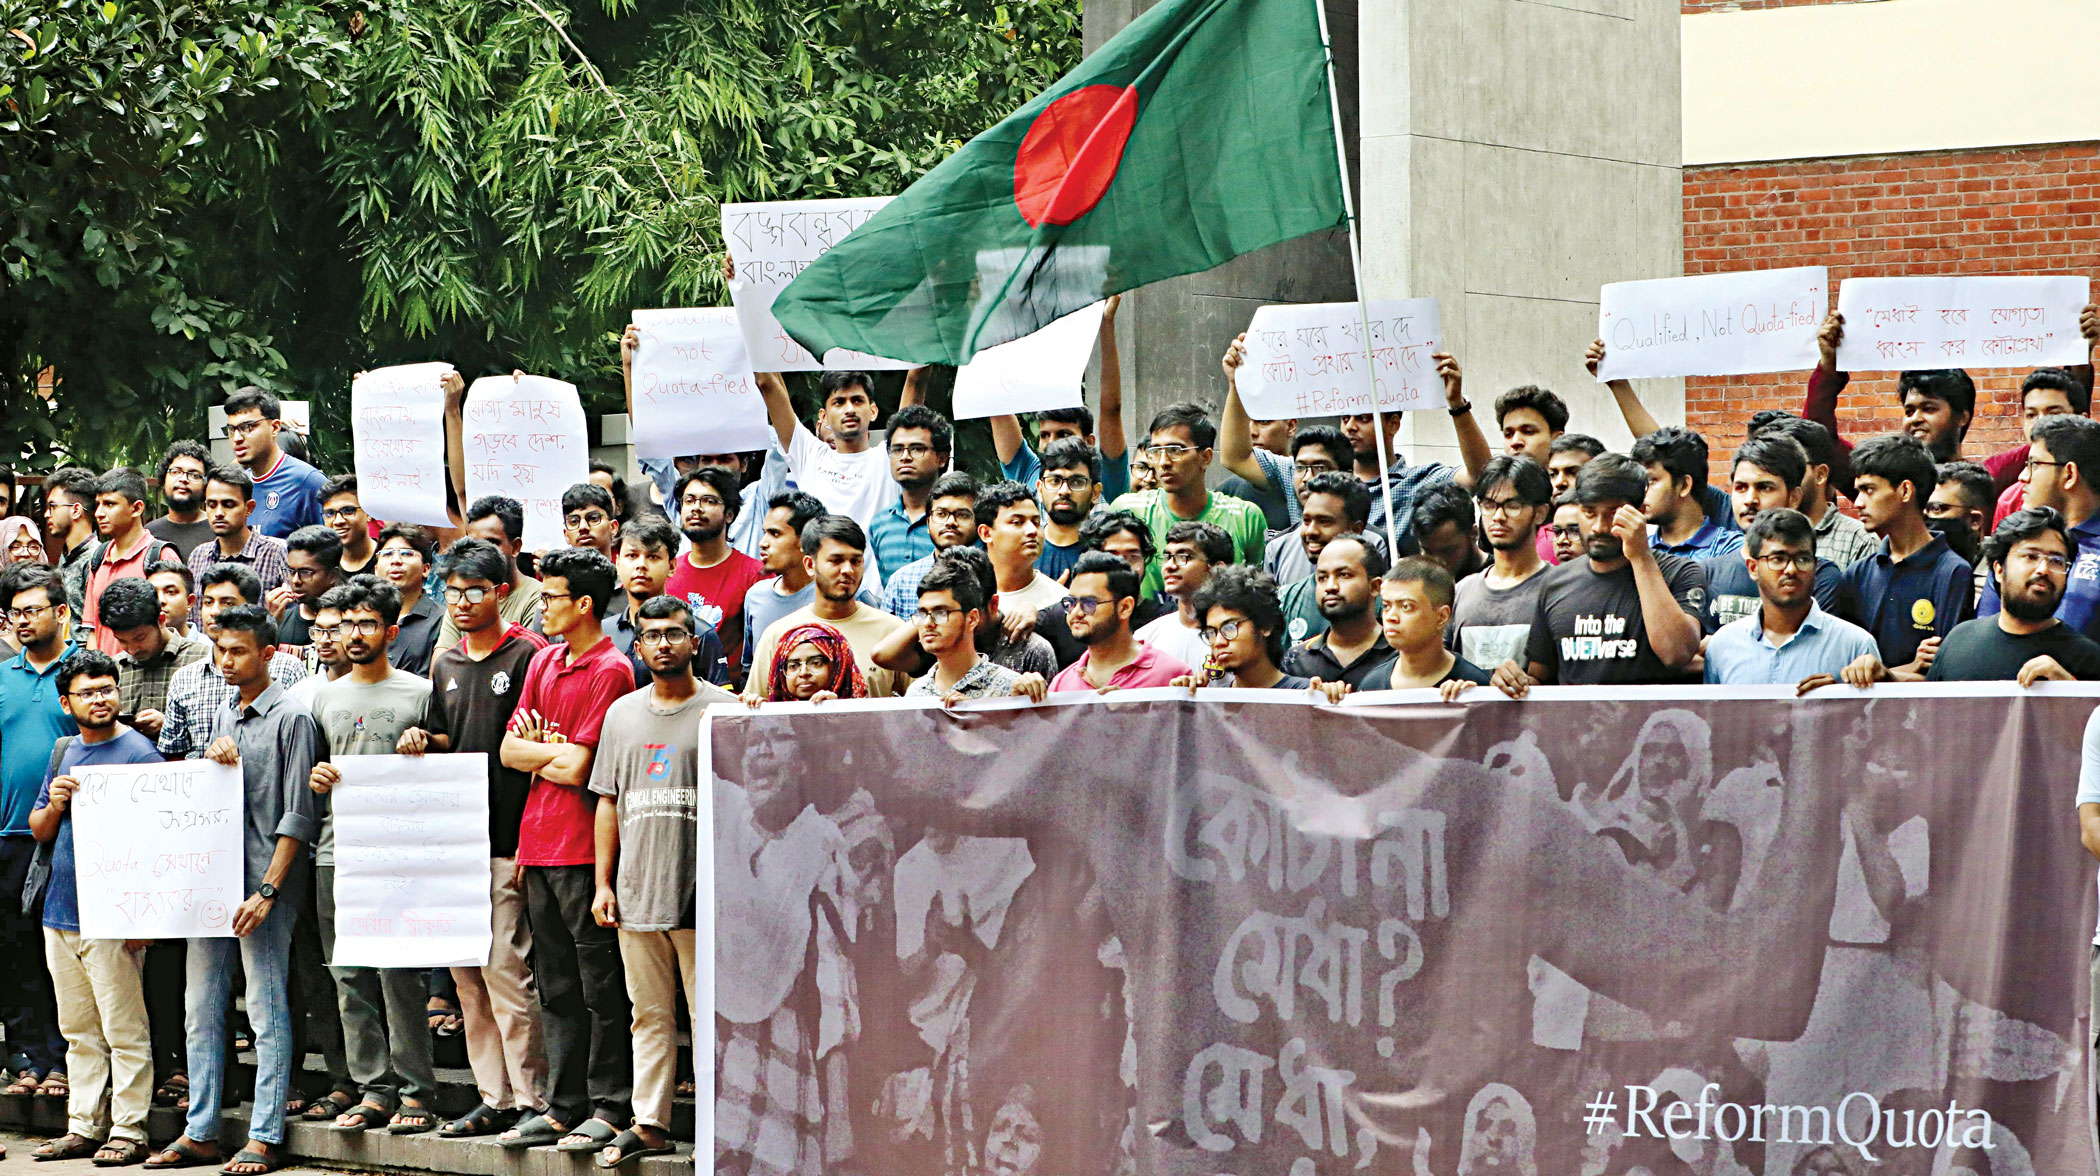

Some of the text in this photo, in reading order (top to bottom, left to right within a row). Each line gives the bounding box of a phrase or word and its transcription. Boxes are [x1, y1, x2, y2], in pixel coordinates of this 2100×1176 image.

[1393, 316, 1414, 345] দে
[1702, 306, 1734, 338] Not
[1574, 613, 1626, 635] Into the
[1583, 1083, 1998, 1162] #ReformQuota
